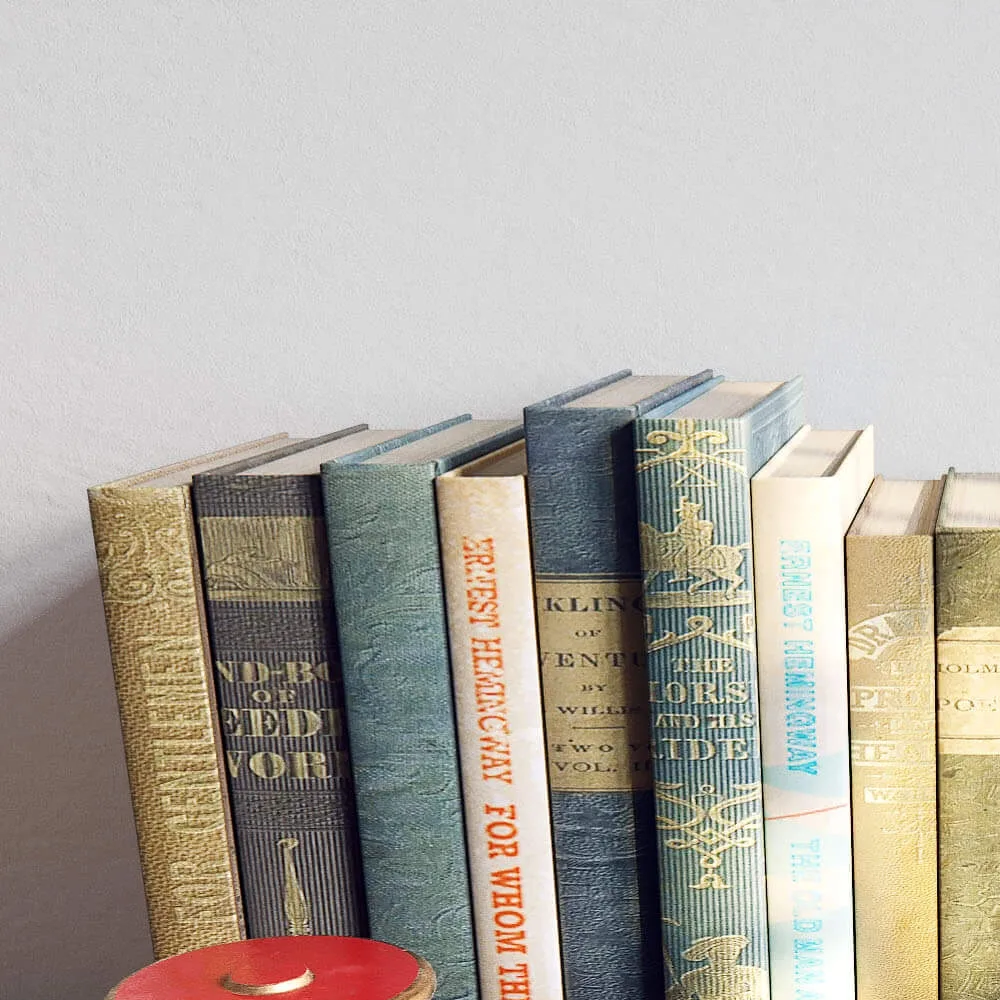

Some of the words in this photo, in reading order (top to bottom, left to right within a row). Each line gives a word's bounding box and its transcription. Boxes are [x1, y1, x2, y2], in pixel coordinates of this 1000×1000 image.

[780, 539, 813, 632] ERNEST
[574, 629, 601, 637] OF
[673, 658, 735, 673] THE
[252, 689, 296, 703] OF
[784, 640, 818, 776] HEMINGWAY
[656, 713, 700, 728] AND
[552, 743, 614, 753] TWO
[653, 738, 749, 761] IDE
[552, 762, 618, 773] VOL.
[484, 804, 519, 859] FOR
[490, 866, 527, 954] WHOM
